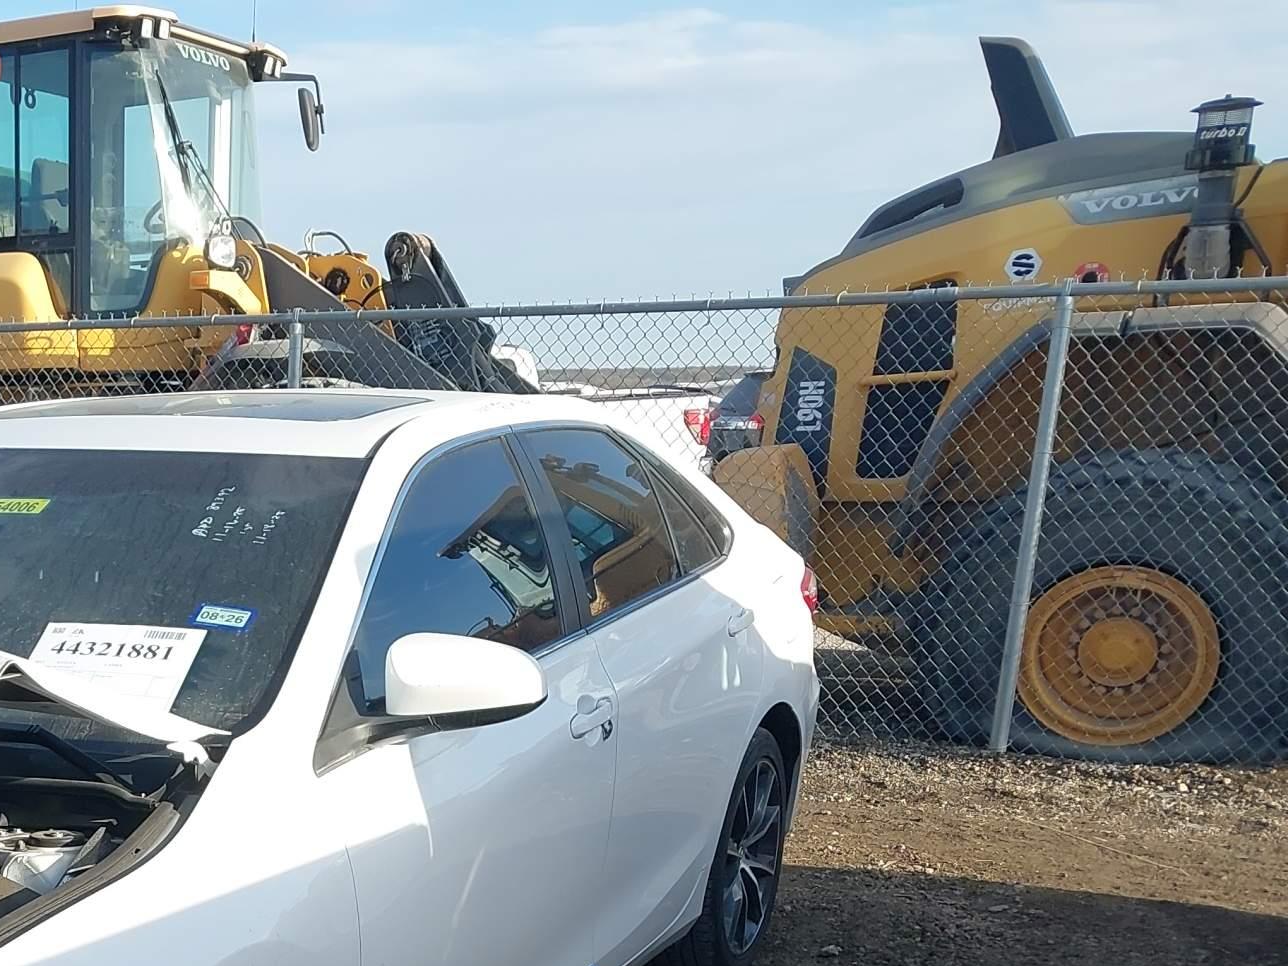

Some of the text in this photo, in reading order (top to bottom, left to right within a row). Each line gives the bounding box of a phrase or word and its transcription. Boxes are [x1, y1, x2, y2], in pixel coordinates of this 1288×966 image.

[174, 41, 232, 72] VOLVO
[1199, 126, 1235, 140] turbo
[1081, 184, 1201, 214] VOLV
[795, 380, 826, 432] L90H
[50, 640, 175, 661] 44321881
